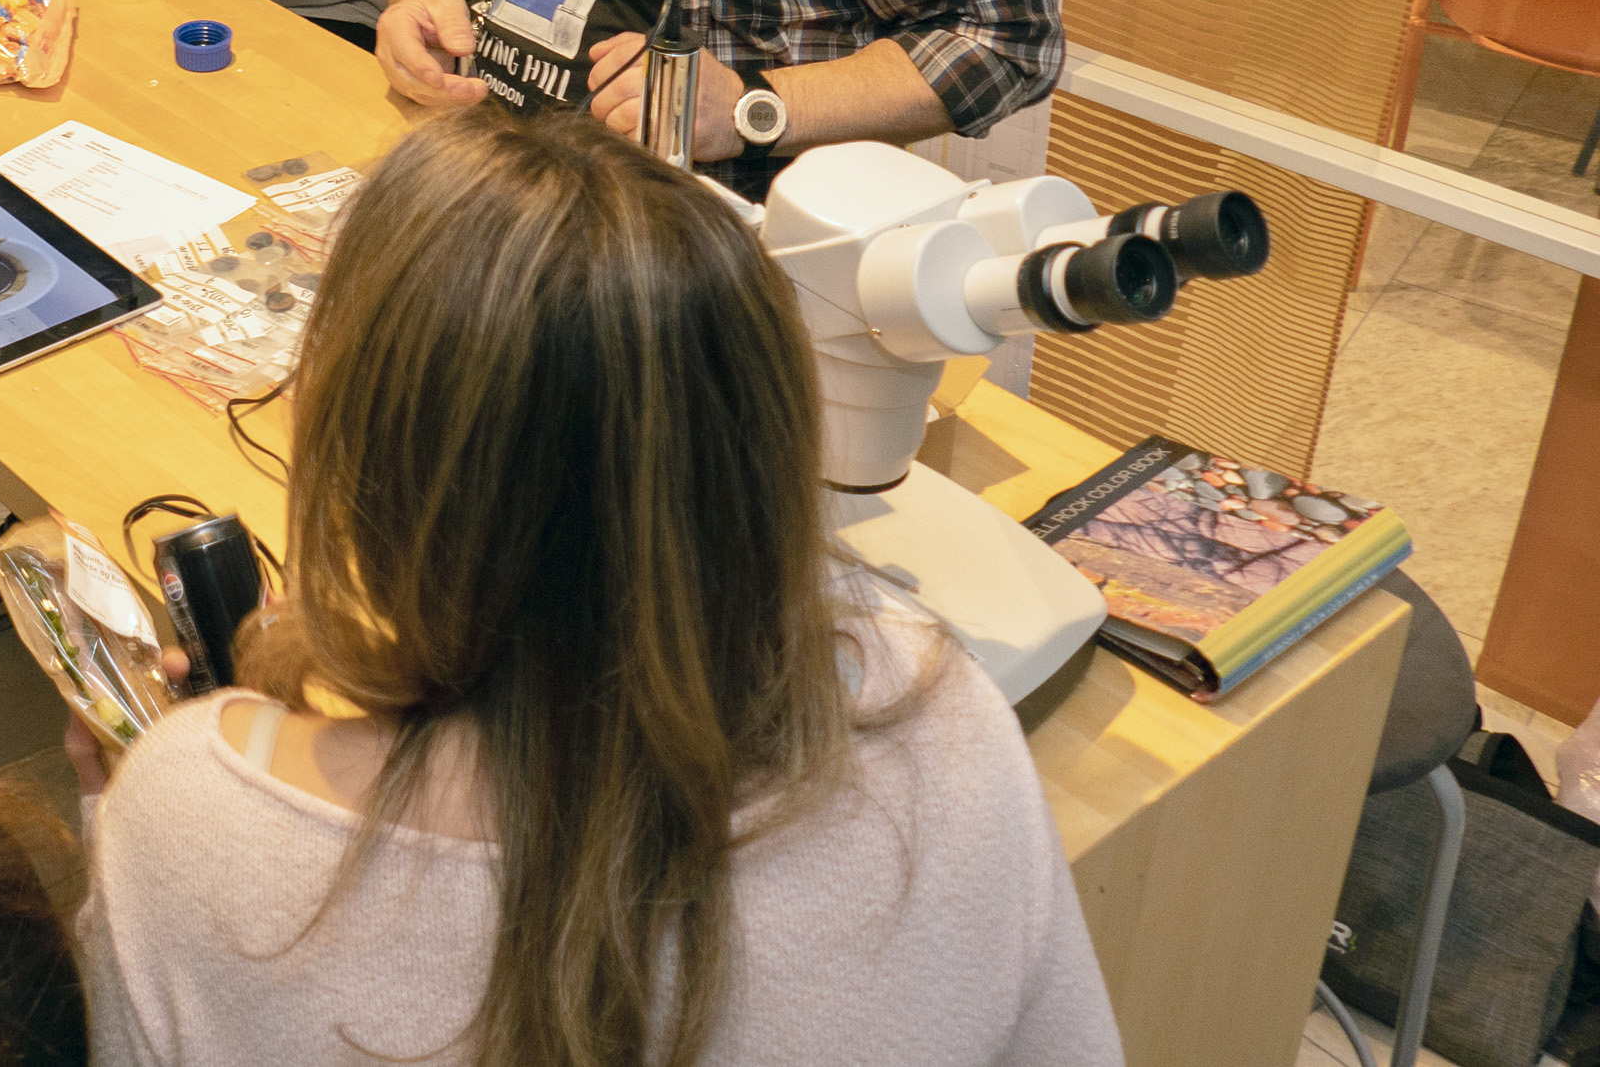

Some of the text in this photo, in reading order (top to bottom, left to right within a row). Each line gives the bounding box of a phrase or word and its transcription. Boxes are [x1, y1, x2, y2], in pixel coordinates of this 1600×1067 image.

[521, 54, 572, 102] HILL
[1051, 497, 1097, 524] ROCK
[1087, 469, 1139, 500] COLOR
[1127, 447, 1173, 473] BOOK
